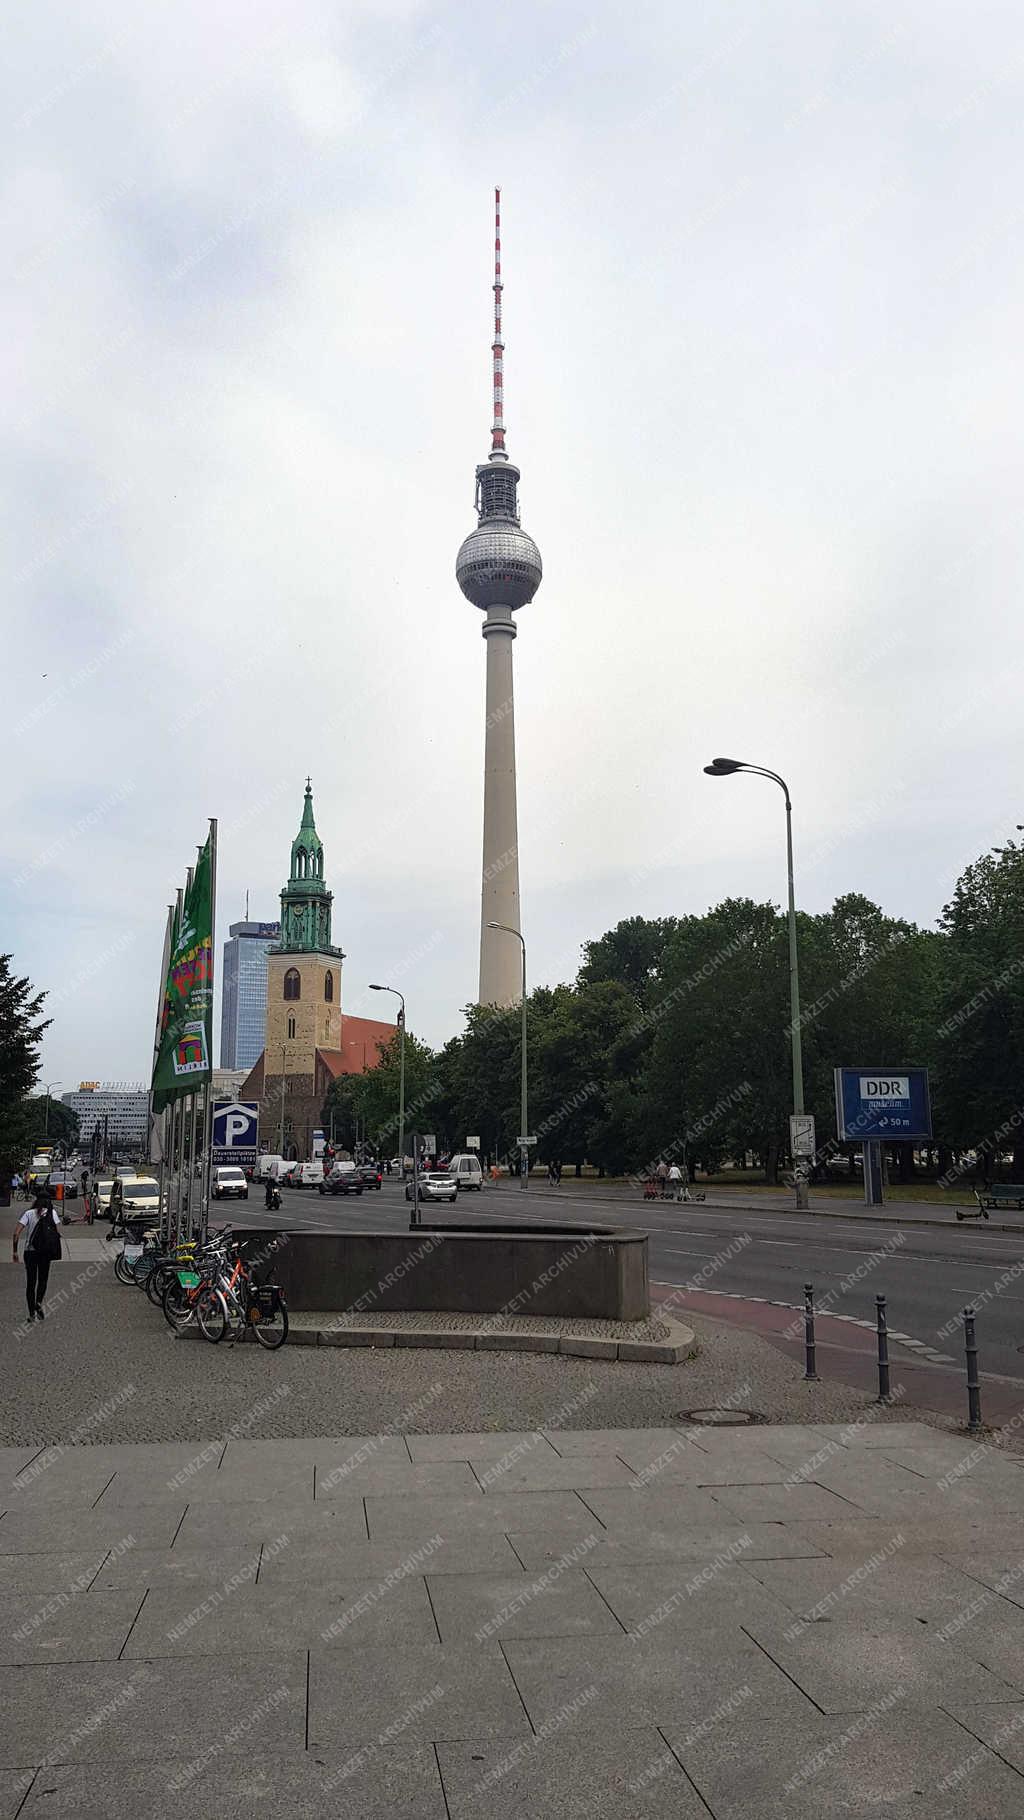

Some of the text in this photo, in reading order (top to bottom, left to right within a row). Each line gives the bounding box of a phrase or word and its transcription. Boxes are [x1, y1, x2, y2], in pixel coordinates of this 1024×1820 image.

[867, 1081, 902, 1096] DDR
[890, 1118, 901, 1126] 50
[225, 1114, 249, 1146] P
